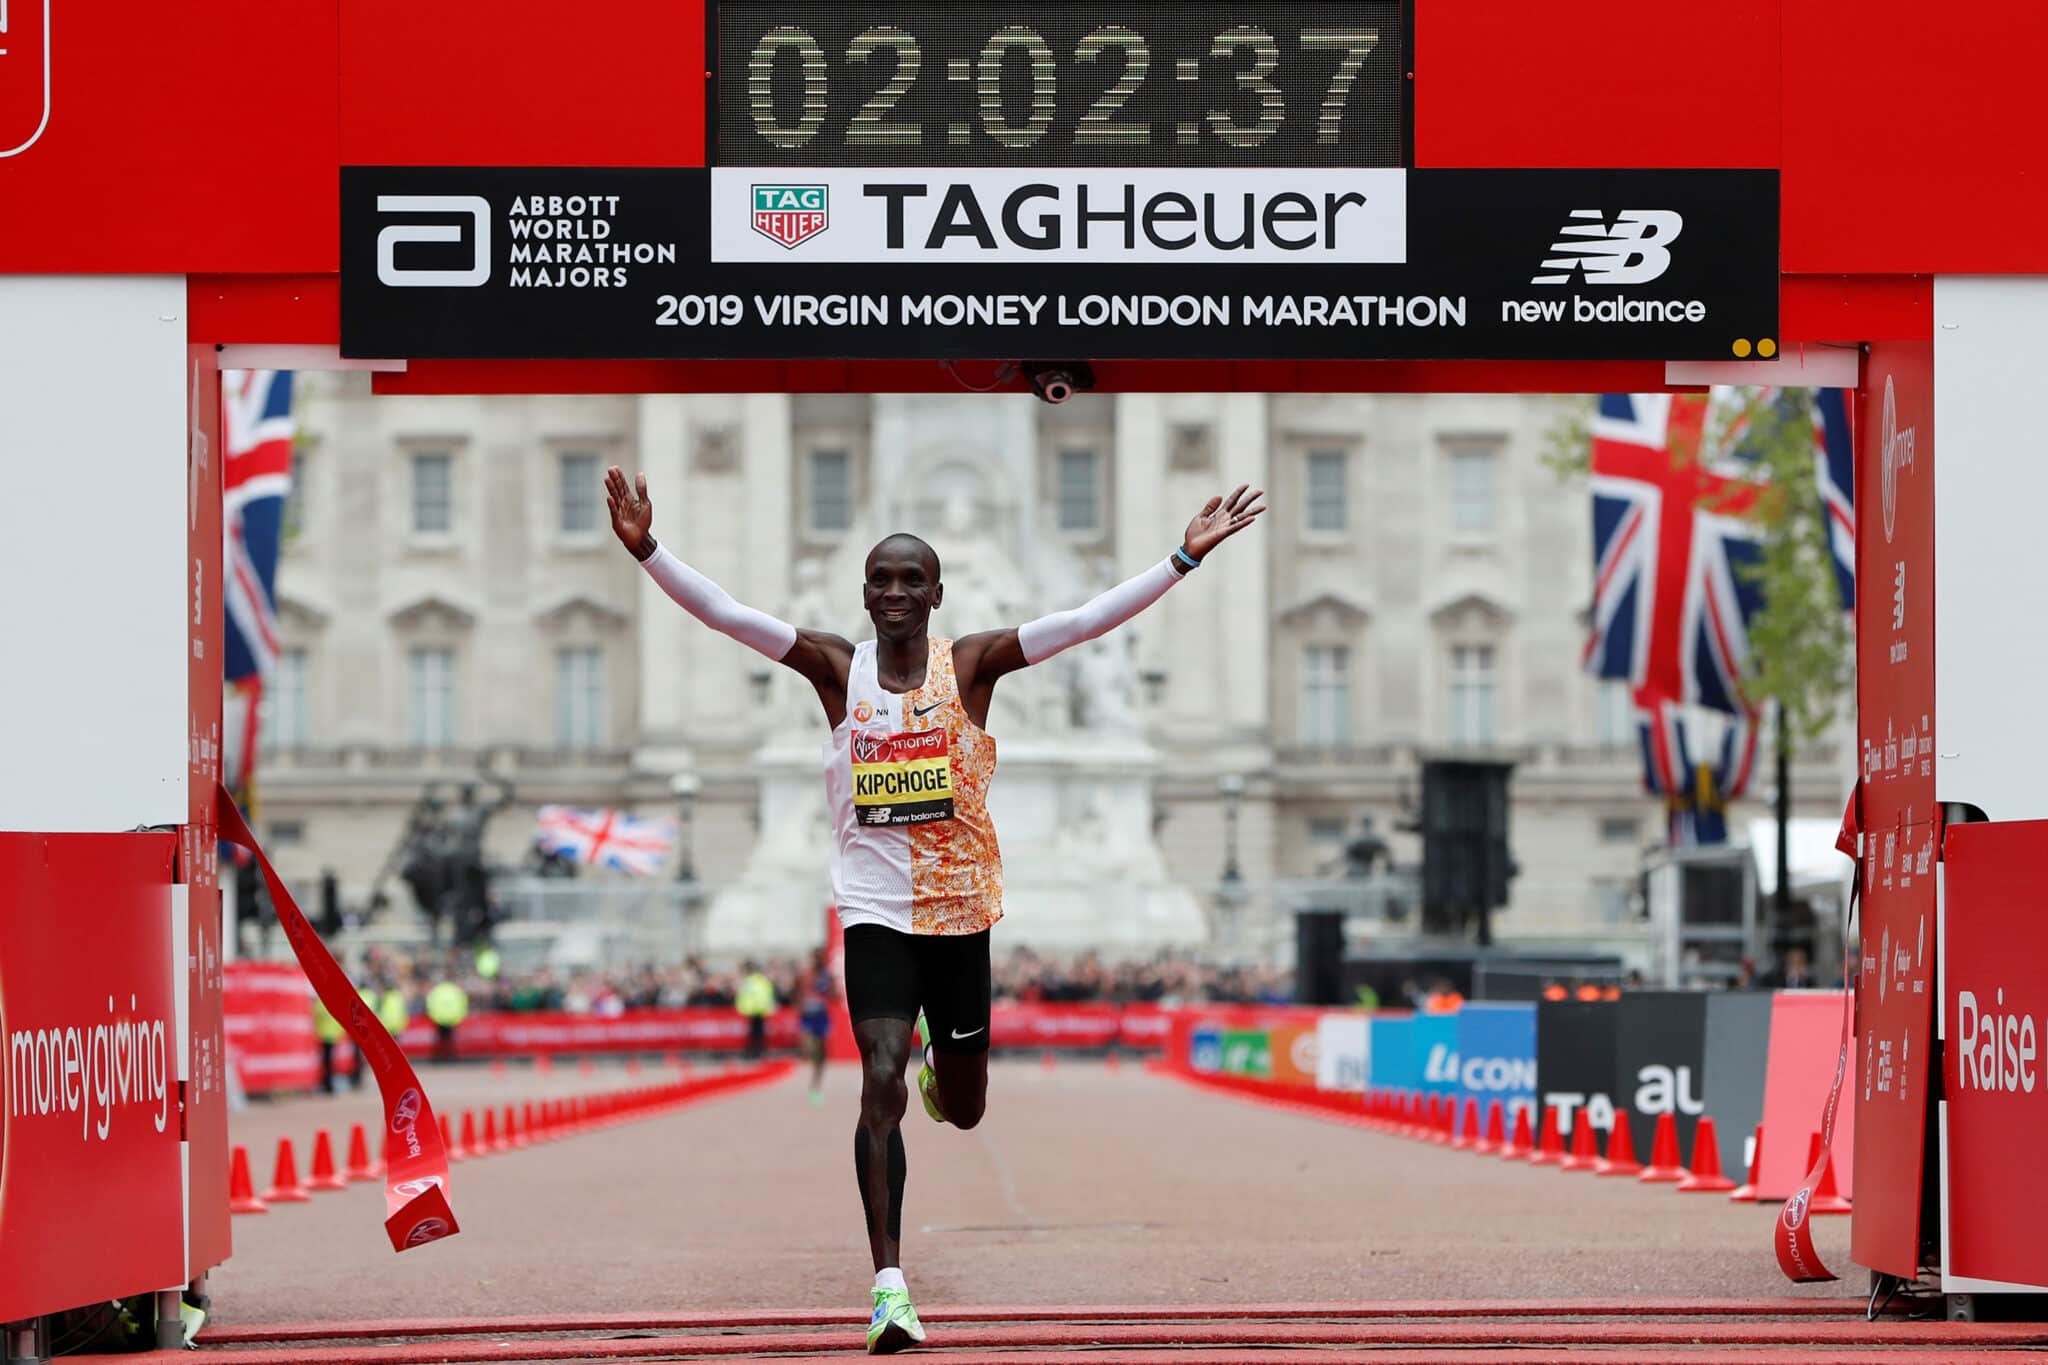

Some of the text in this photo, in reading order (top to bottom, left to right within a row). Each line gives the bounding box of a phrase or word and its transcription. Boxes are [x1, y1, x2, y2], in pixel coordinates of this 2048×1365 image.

[747, 25, 1380, 149] 02:02:37
[509, 195, 620, 216] ABBOTT
[759, 190, 821, 209] TAG
[509, 219, 610, 240] WORLD
[757, 213, 823, 242] HEUER
[509, 243, 676, 264] MARATHON
[509, 266, 628, 288] MAJORS
[655, 294, 1466, 327] 2019 VIRGIN MONEY LONDON MARATHON
[1502, 294, 1706, 323] new balance
[876, 708, 889, 717] NN
[892, 734, 943, 751] money
[856, 768, 948, 796] KIPCHOGE
[911, 812, 946, 822] balance
[1958, 986, 2037, 1094] Raise
